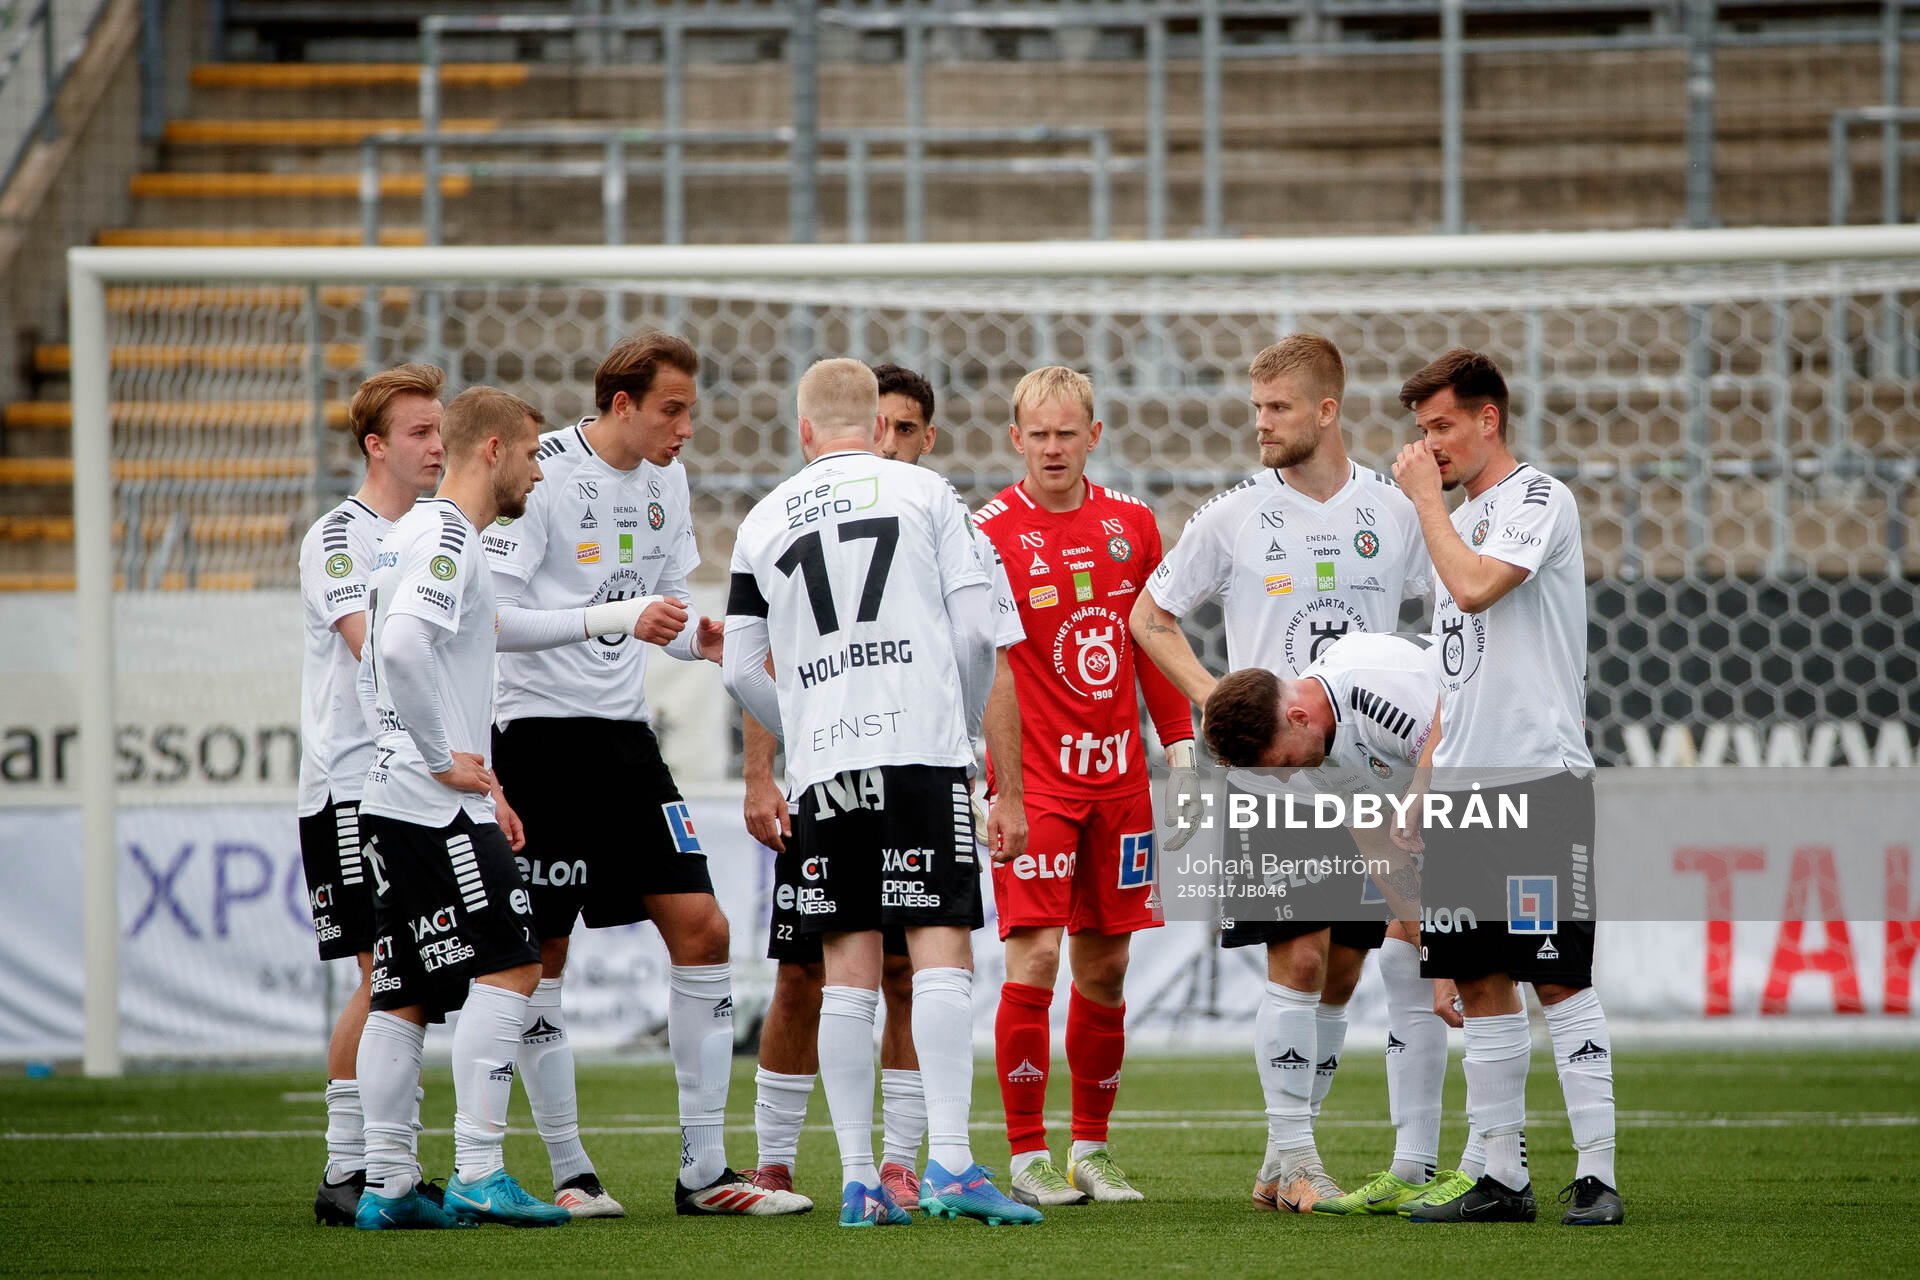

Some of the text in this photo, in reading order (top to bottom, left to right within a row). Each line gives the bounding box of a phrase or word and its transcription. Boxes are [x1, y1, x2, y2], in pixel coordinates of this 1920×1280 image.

[786, 484, 831, 516] pre
[788, 499, 852, 530] zero
[482, 534, 518, 552] UNIBET
[774, 516, 900, 637] 17
[326, 584, 367, 602] UNIBET
[417, 585, 456, 609] UNIBET
[1306, 597, 1345, 612] HJÄRTA
[1053, 620, 1074, 674] STOLTHET,
[1071, 606, 1107, 622] HJÄRTA
[1059, 729, 1130, 775] itsy
[1274, 904, 1293, 922] 16
[777, 924, 793, 941] 22
[1536, 952, 1560, 960] SELECT
[523, 1033, 563, 1044] SELECT
[1569, 1053, 1609, 1064] SELECT
[1007, 1075, 1044, 1083] SELECT
